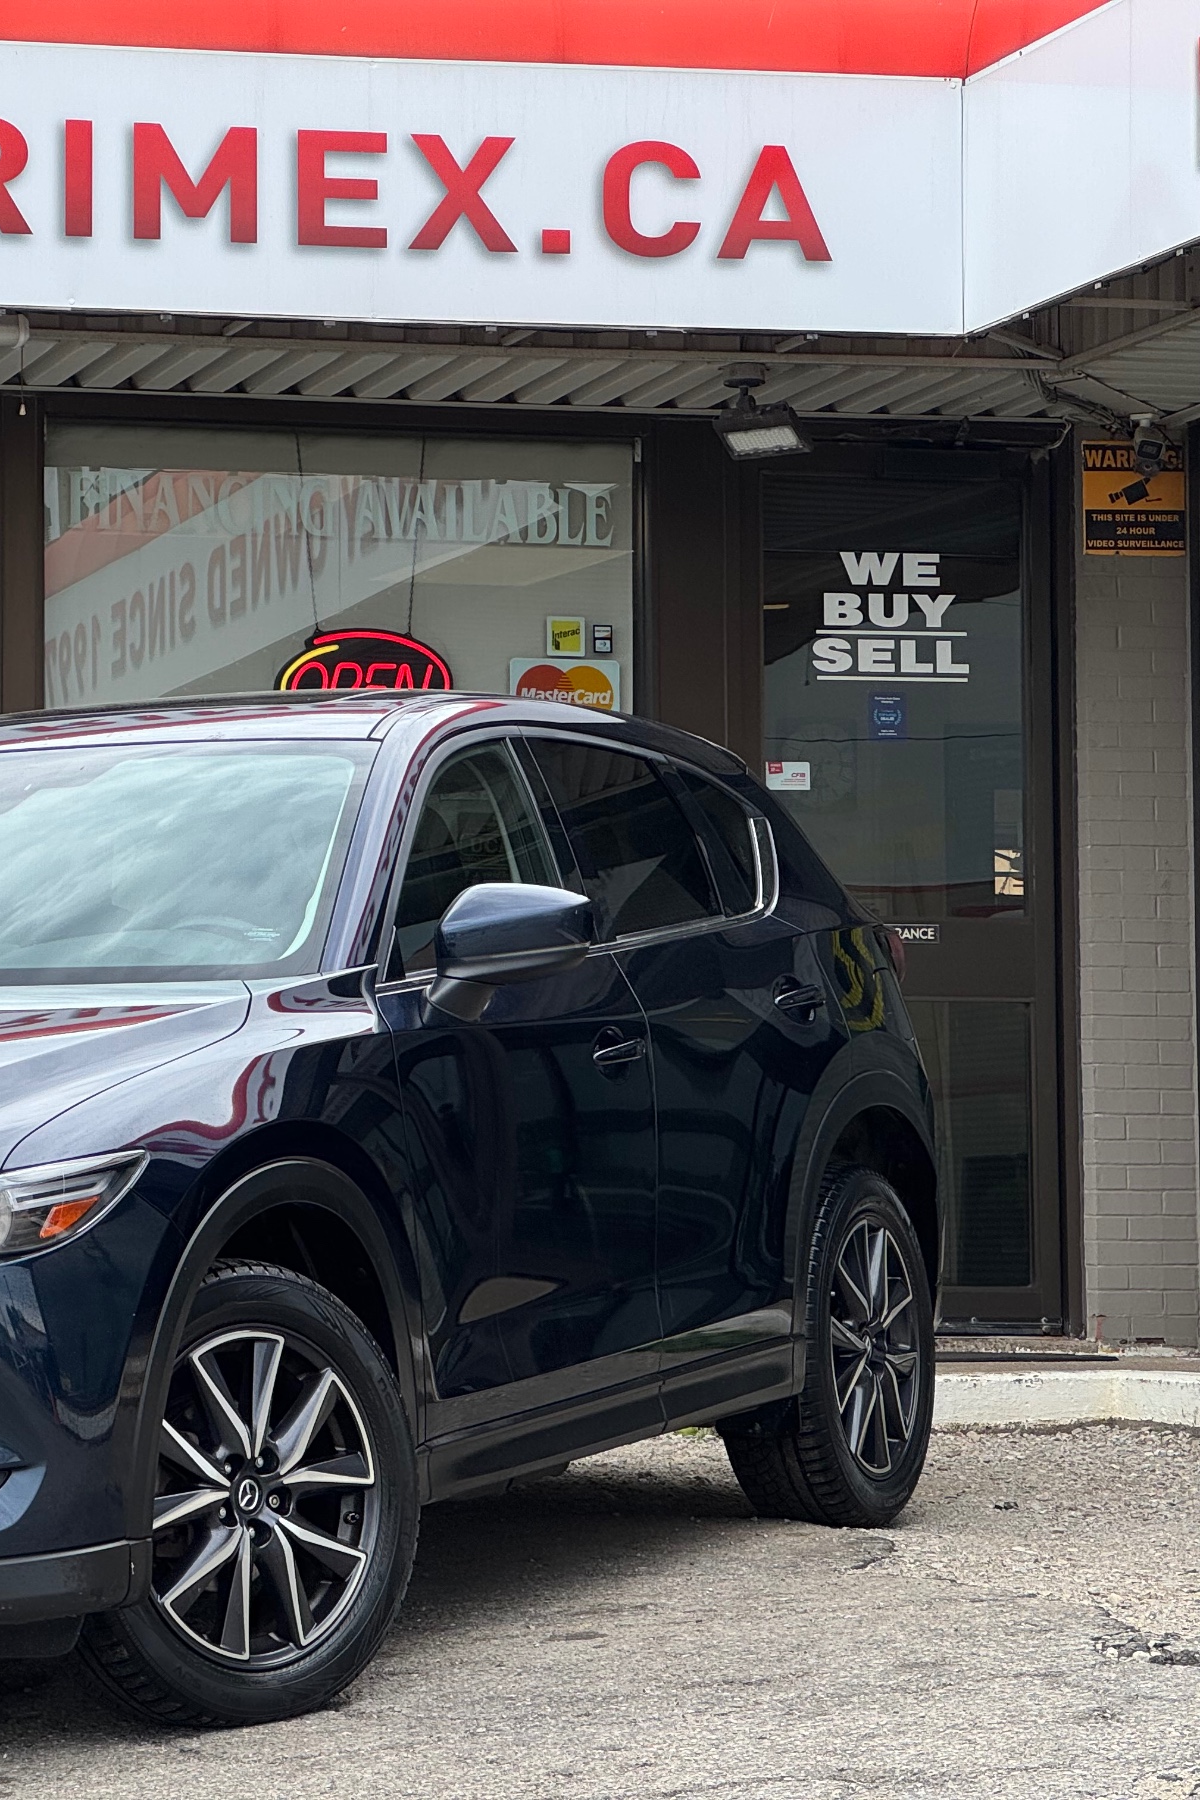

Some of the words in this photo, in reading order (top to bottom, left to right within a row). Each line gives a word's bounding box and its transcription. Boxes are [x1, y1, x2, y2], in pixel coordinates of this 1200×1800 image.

[68, 469, 333, 538] FINANCING
[355, 479, 615, 547] AVAILABLE
[1091, 513, 1112, 521] THIS
[1115, 514, 1135, 522] SITE
[1137, 514, 1146, 522] IS
[1148, 514, 1179, 522] UNDER
[1087, 539, 1115, 548] VIDEO
[1117, 540, 1184, 548] SURVEILLANCE
[1116, 526, 1127, 535] 24
[1129, 526, 1155, 535] HOUR
[839, 551, 941, 587] WE
[823, 592, 957, 628] BUY
[812, 637, 970, 674] SELL
[520, 687, 612, 705] MasterCard
